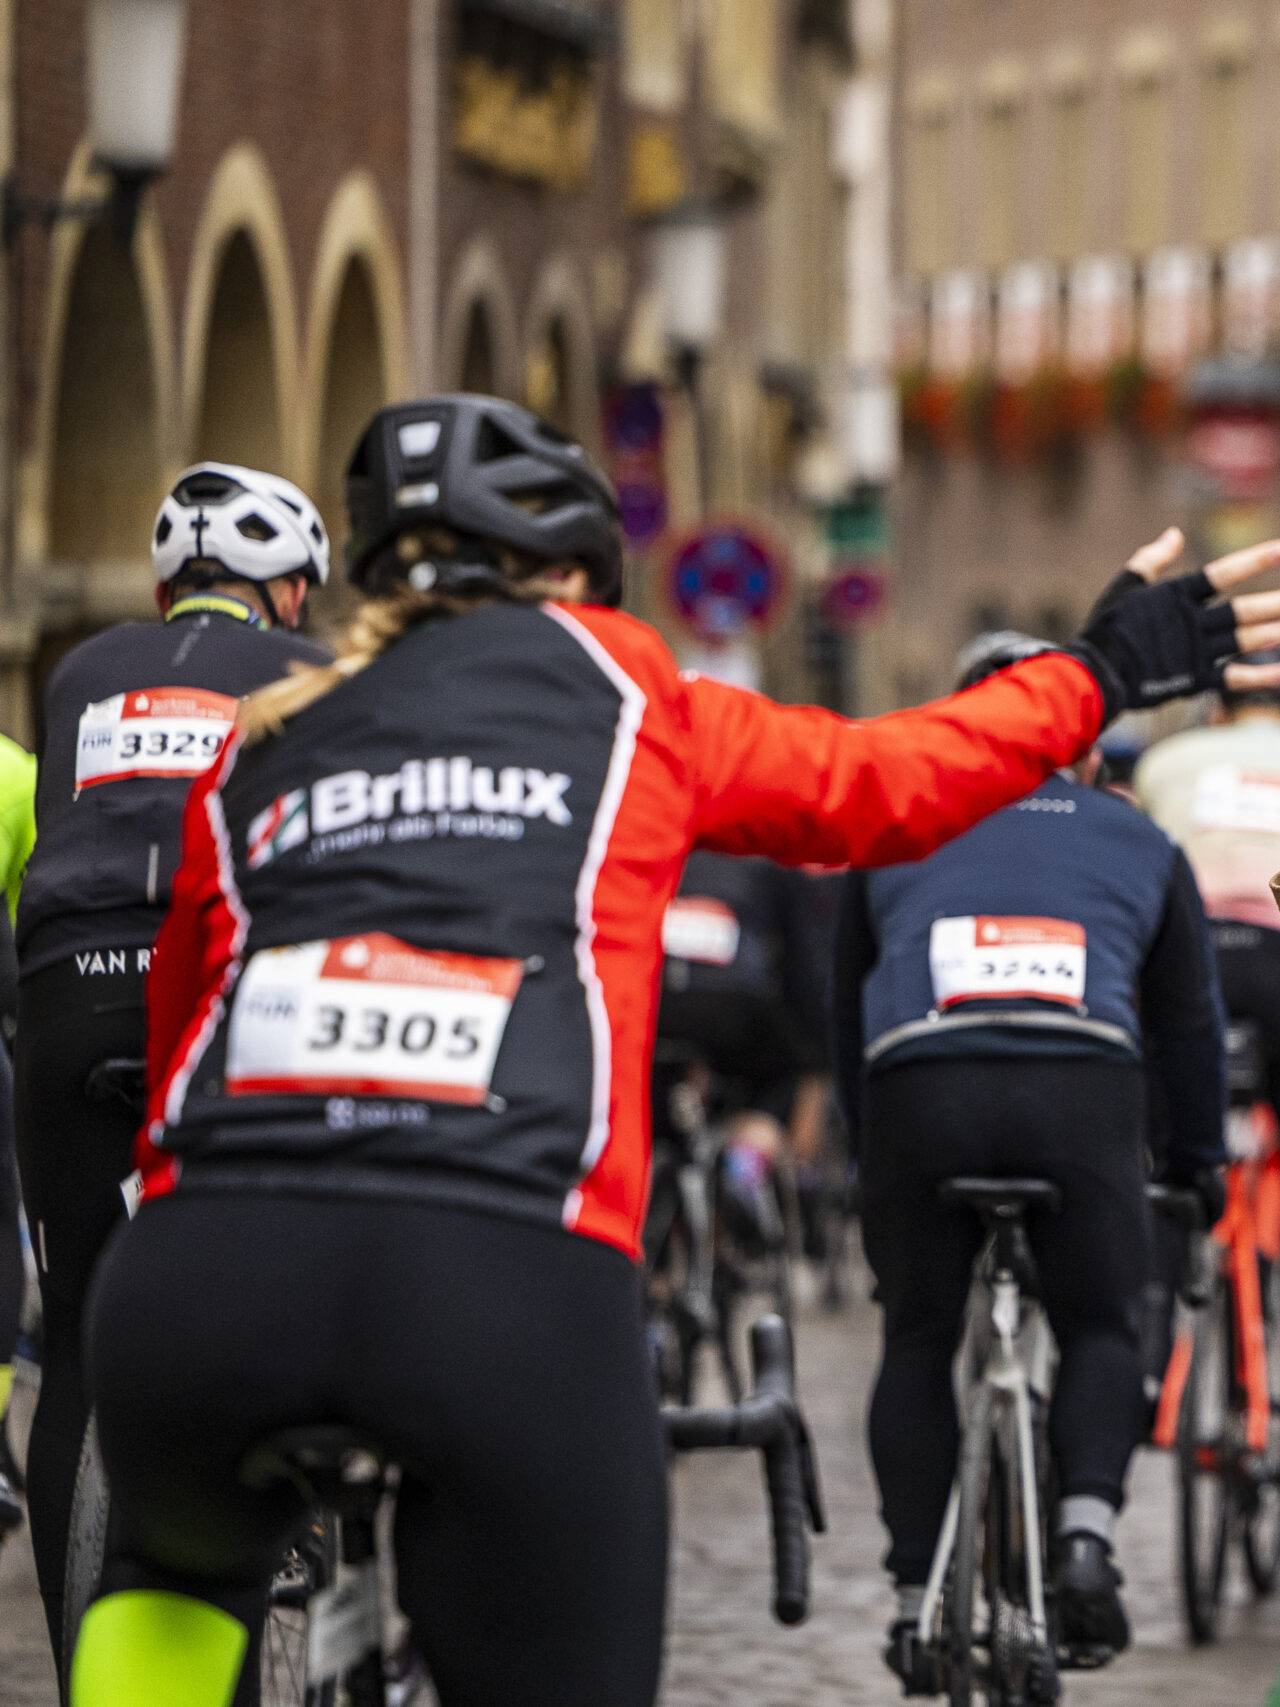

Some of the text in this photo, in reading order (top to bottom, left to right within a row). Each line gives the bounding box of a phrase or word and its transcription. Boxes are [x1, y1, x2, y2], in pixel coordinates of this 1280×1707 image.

[120, 730, 224, 759] 3329
[311, 756, 573, 827] Brillux
[75, 949, 126, 976] VAN
[307, 1004, 482, 1060] 3305
